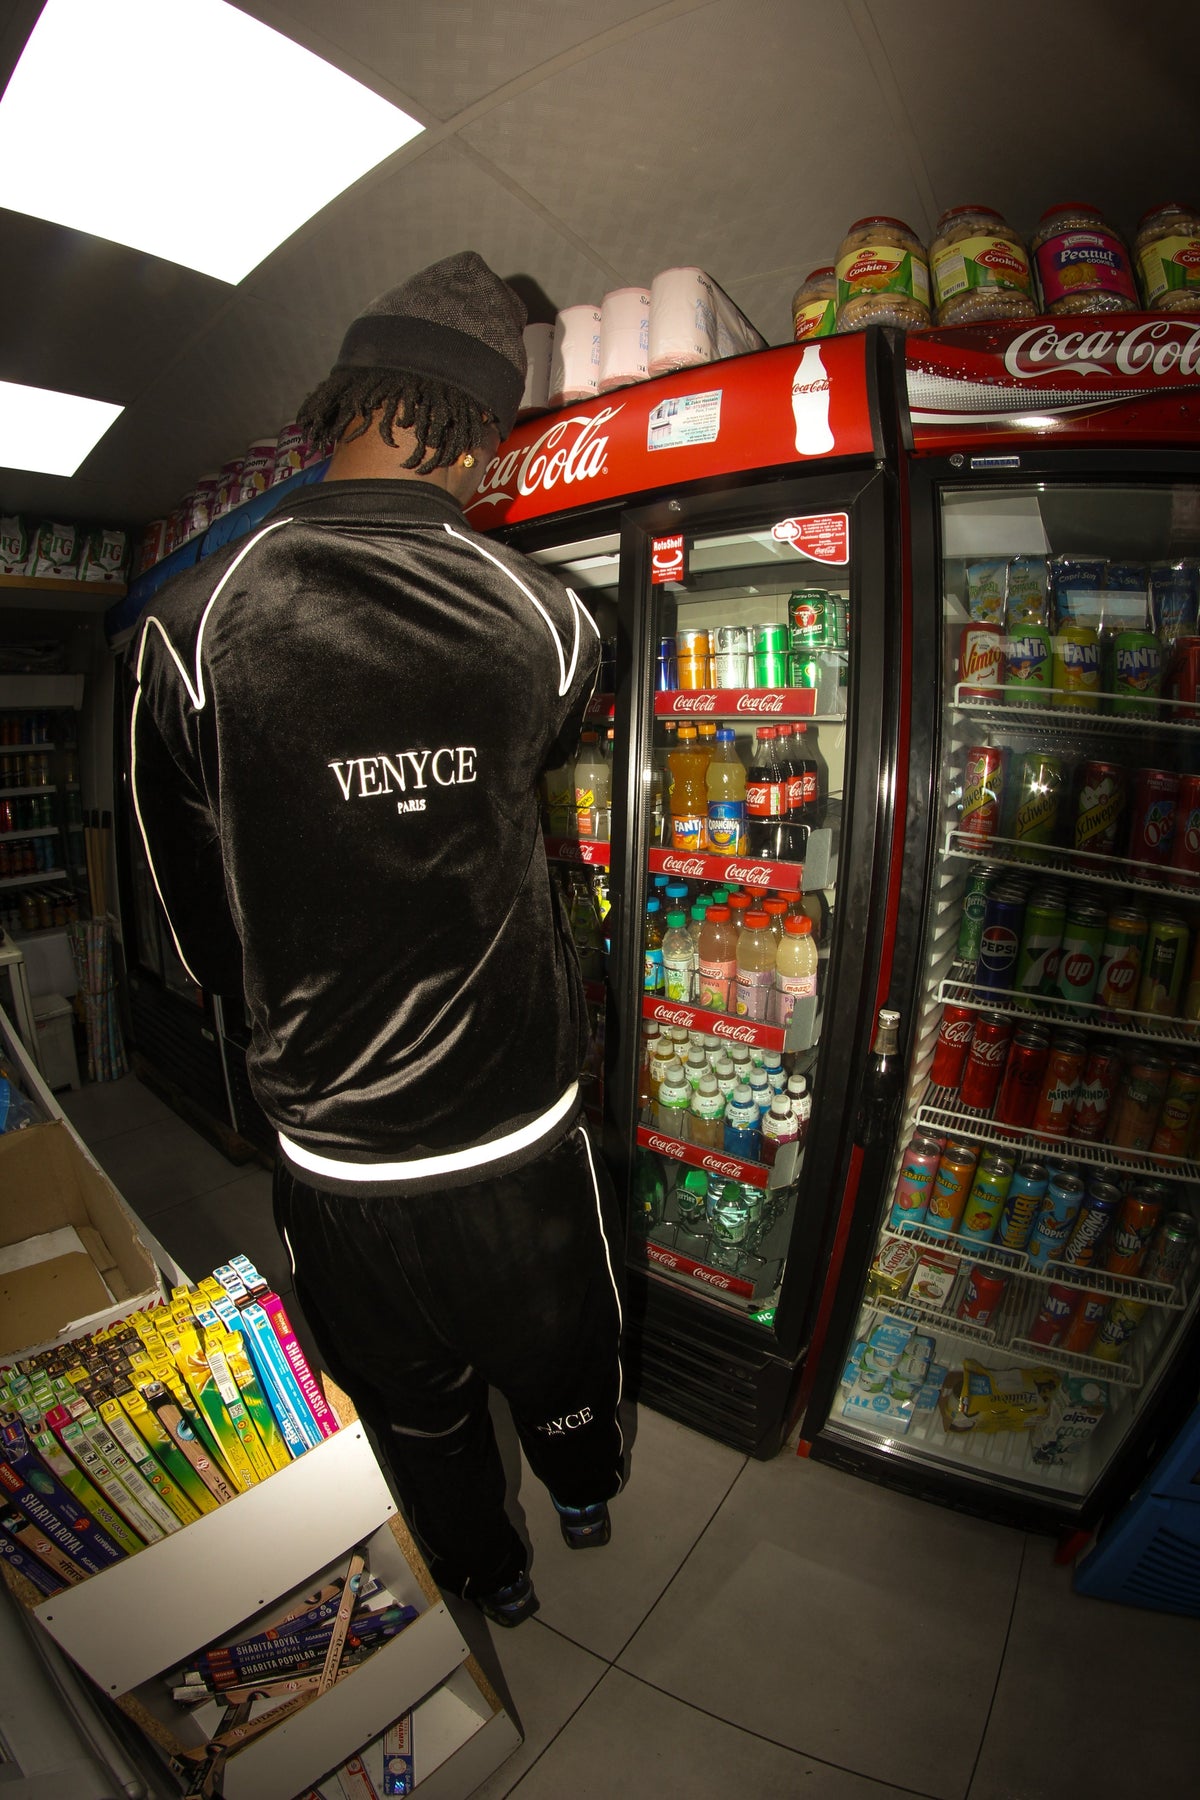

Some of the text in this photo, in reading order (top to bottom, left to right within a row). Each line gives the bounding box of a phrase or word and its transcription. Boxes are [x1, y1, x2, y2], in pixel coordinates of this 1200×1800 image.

[984, 254, 1023, 273] Cookies
[1060, 249, 1114, 263] Peanut
[1086, 258, 1115, 268] COOKIES
[848, 264, 888, 278] Cookies
[791, 378, 831, 395] Coca-Cola
[653, 537, 683, 551] RotoShelf
[961, 643, 1001, 678] Vimto
[673, 693, 718, 712] Coca-Cola
[736, 693, 786, 712] Coca-Cola
[328, 747, 477, 801] VENYCE
[747, 788, 768, 804] Cola
[397, 799, 426, 815] PARIS
[662, 855, 707, 877] Coca-Cola
[724, 863, 774, 885] Coca-Cola
[981, 940, 1018, 954] PEPSI
[1067, 962, 1093, 980] up
[654, 1005, 696, 1028] Coca-Cola
[712, 1020, 758, 1043] Coca-Cola
[649, 1135, 686, 1158] Coca-Cola
[703, 1155, 744, 1178] Coca-Cola
[1065, 1209, 1107, 1264] ORANGINA
[693, 1268, 731, 1290] Coca-Cola
[1046, 1296, 1071, 1315] NTA
[757, 1311, 774, 1323] HC
[1104, 1321, 1125, 1339] NTA
[286, 1341, 309, 1383] SHARITA
[303, 1380, 328, 1419] CLASSIC
[1062, 1411, 1098, 1426] alpro
[1056, 1425, 1091, 1439] COCO
[21, 1493, 61, 1532] SHARITA
[54, 1527, 85, 1555] ROYAL
[236, 1641, 273, 1656] SHARITA
[273, 1635, 300, 1651] ROYAL
[241, 1649, 316, 1676] SHARITA POPULAR
